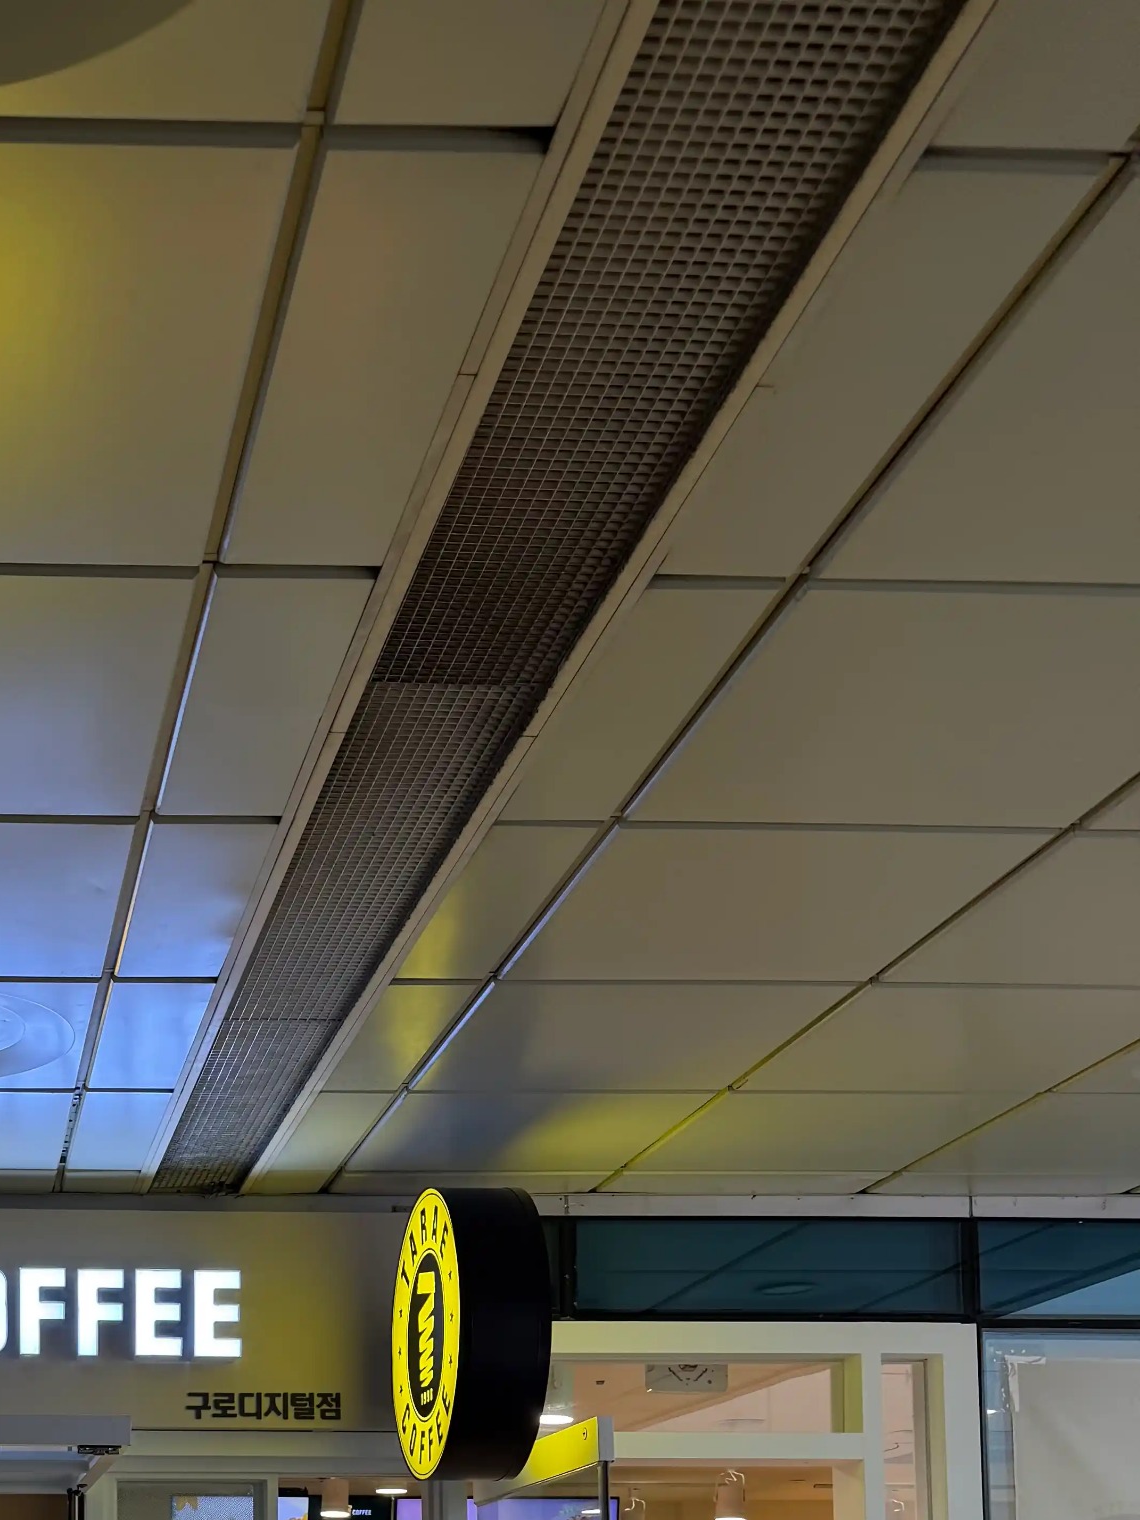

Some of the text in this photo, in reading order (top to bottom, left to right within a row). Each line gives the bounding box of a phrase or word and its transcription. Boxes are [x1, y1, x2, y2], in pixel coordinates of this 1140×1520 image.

[401, 1205, 448, 1288] TARAE
[185, 1392, 342, 1420] 구로디지털점
[401, 1383, 451, 1464] COFFEE
